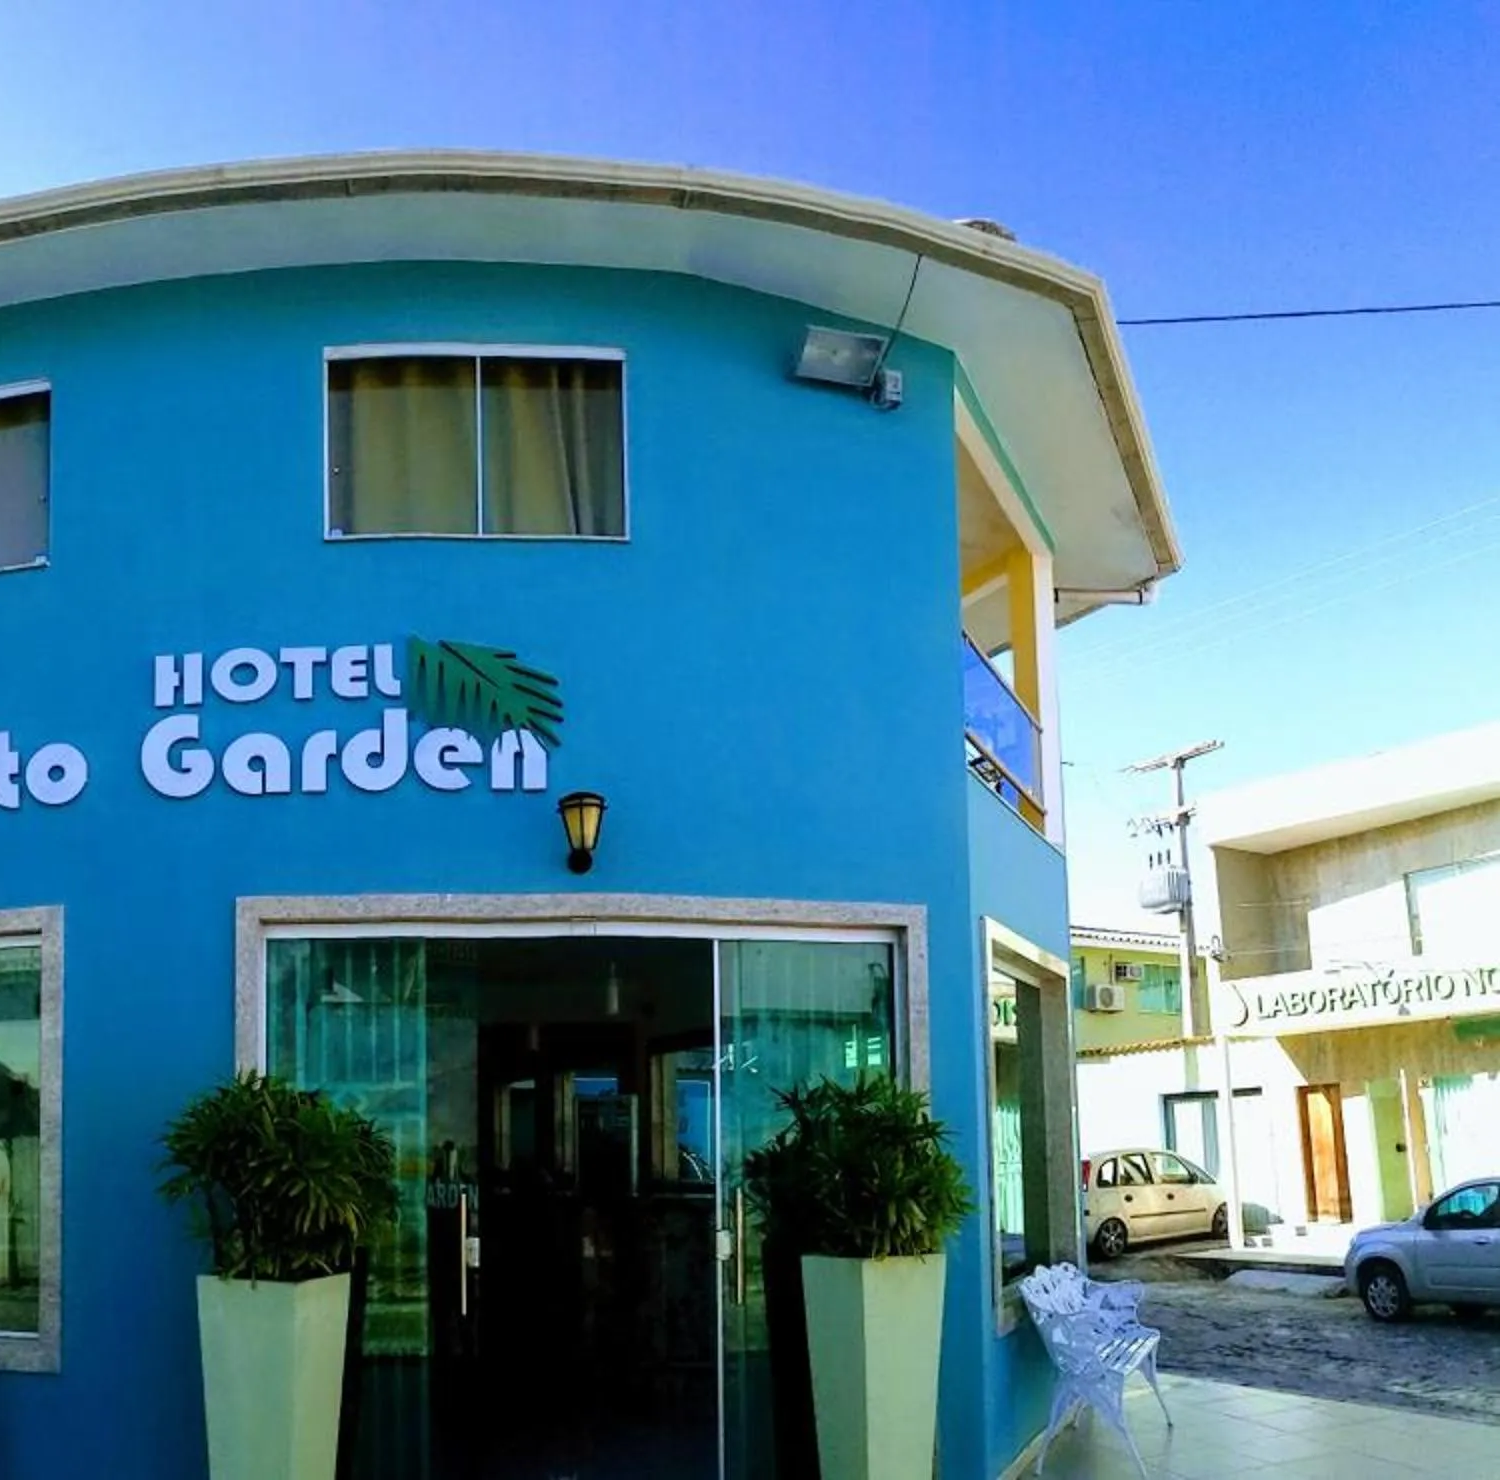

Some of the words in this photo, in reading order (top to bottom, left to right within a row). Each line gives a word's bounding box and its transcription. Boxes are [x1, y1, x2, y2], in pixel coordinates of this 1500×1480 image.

[154, 644, 401, 707] HOTEL
[140, 708, 548, 798] Garden
[1257, 968, 1455, 1020] LABORATÓRIO
